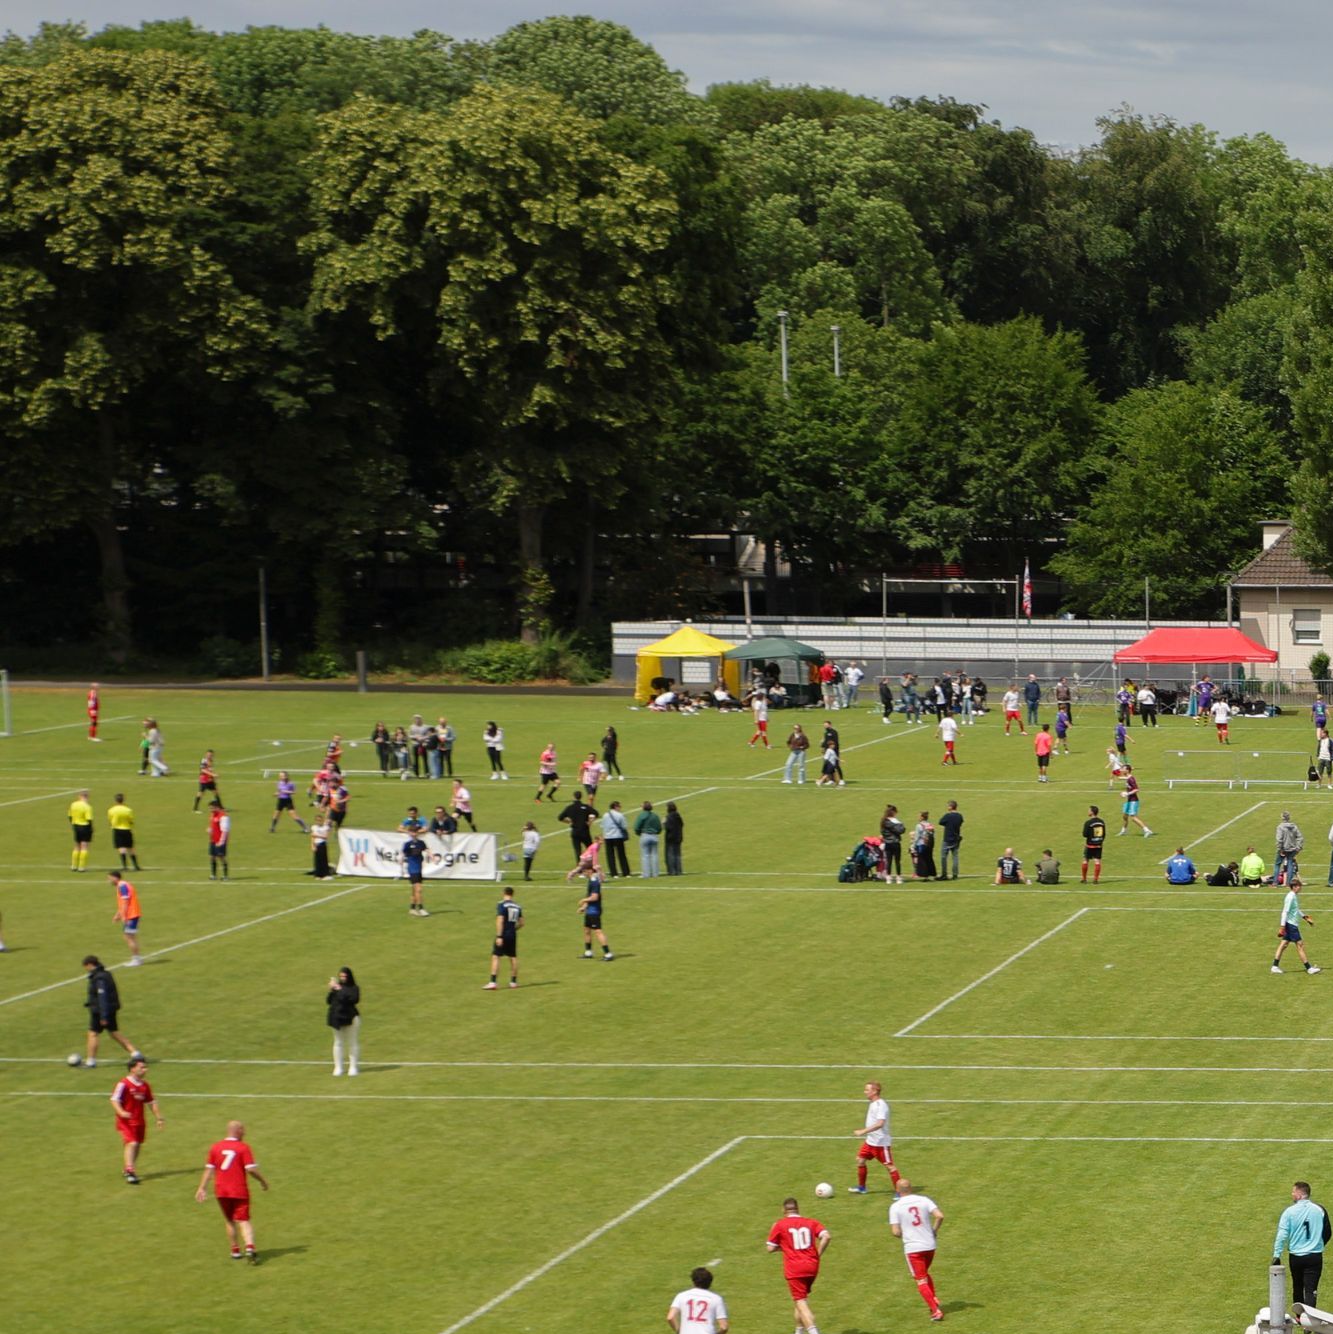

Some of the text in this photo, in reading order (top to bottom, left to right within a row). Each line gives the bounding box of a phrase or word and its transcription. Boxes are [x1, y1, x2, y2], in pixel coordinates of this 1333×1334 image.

[219, 1149, 237, 1171] 7
[908, 1206, 922, 1227] 3
[787, 1226, 813, 1251] 10
[1303, 1219, 1311, 1240] 1
[687, 1298, 709, 1323] 12
